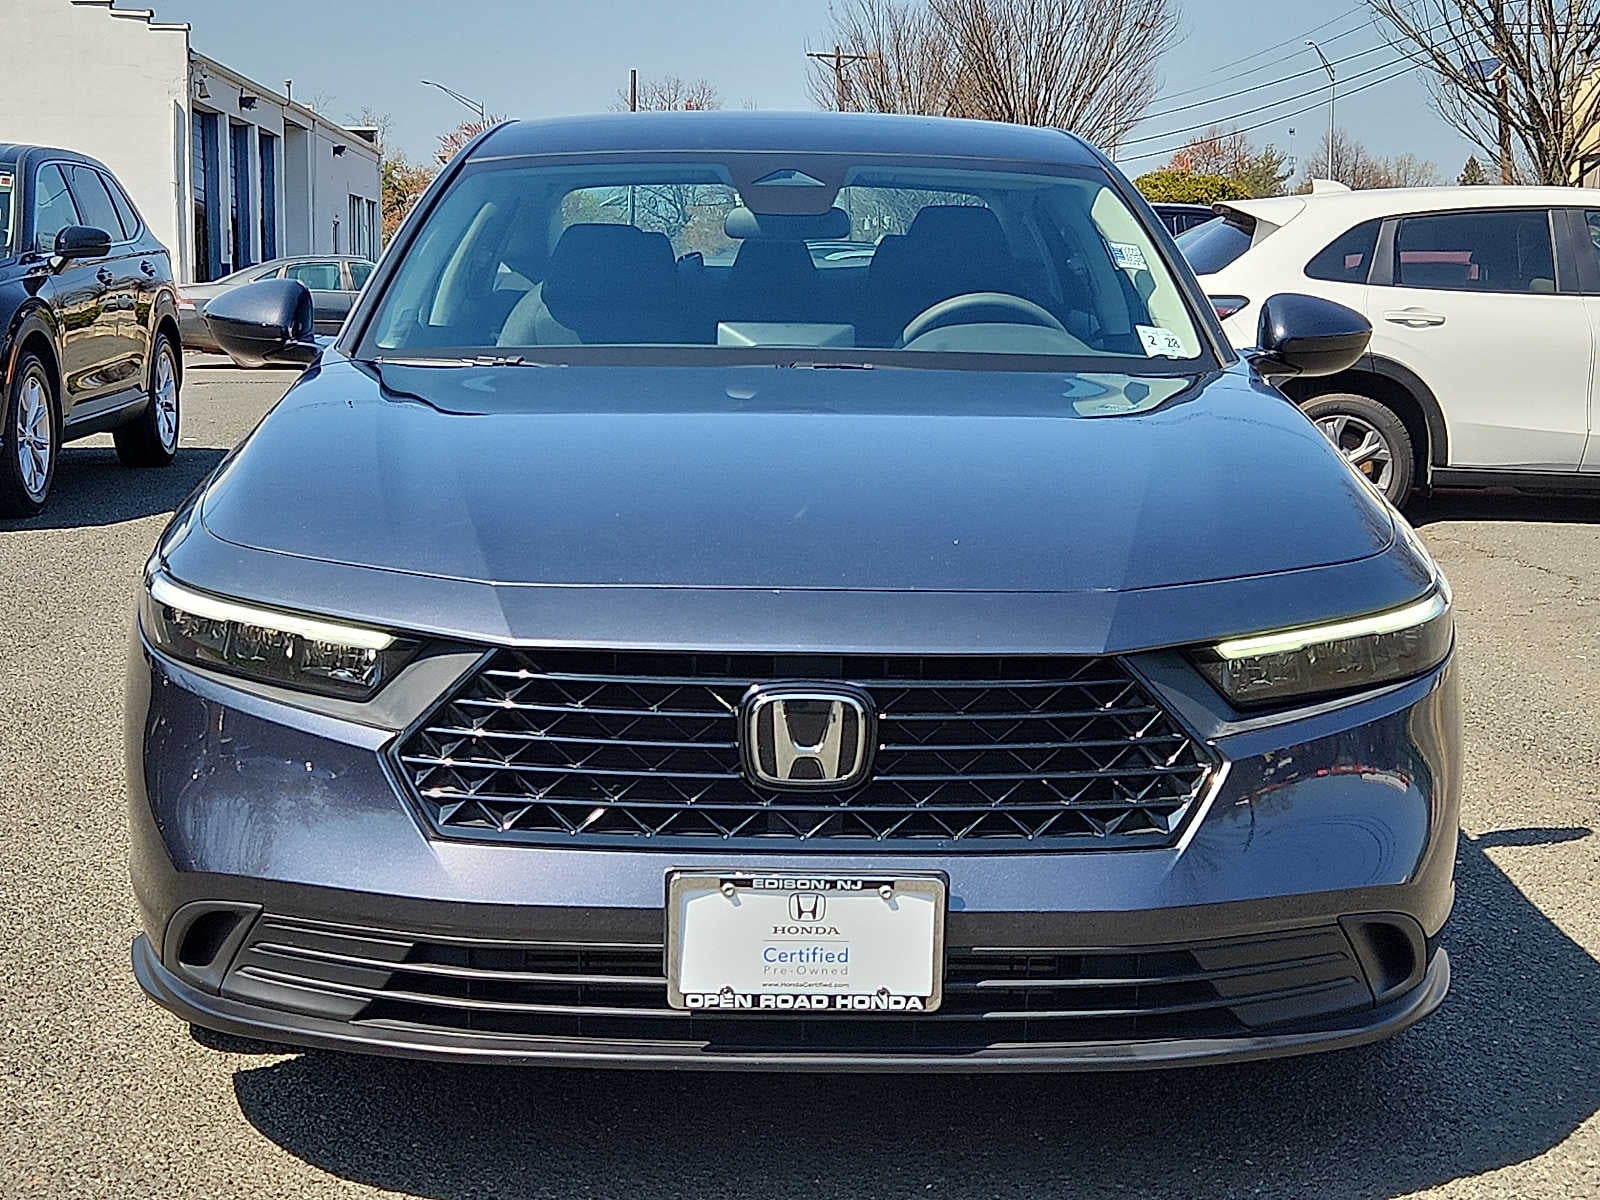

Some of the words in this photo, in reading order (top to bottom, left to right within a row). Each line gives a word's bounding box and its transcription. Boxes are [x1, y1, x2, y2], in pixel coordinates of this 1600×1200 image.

[752, 878, 831, 891] EDISON,
[836, 879, 863, 891] NJ
[772, 926, 841, 935] HONDA
[763, 946, 849, 963] Certified
[763, 965, 849, 976] Pre-Owned
[685, 993, 753, 1009] OPEN
[759, 994, 829, 1010] ROAD
[835, 994, 924, 1011] HONDA
